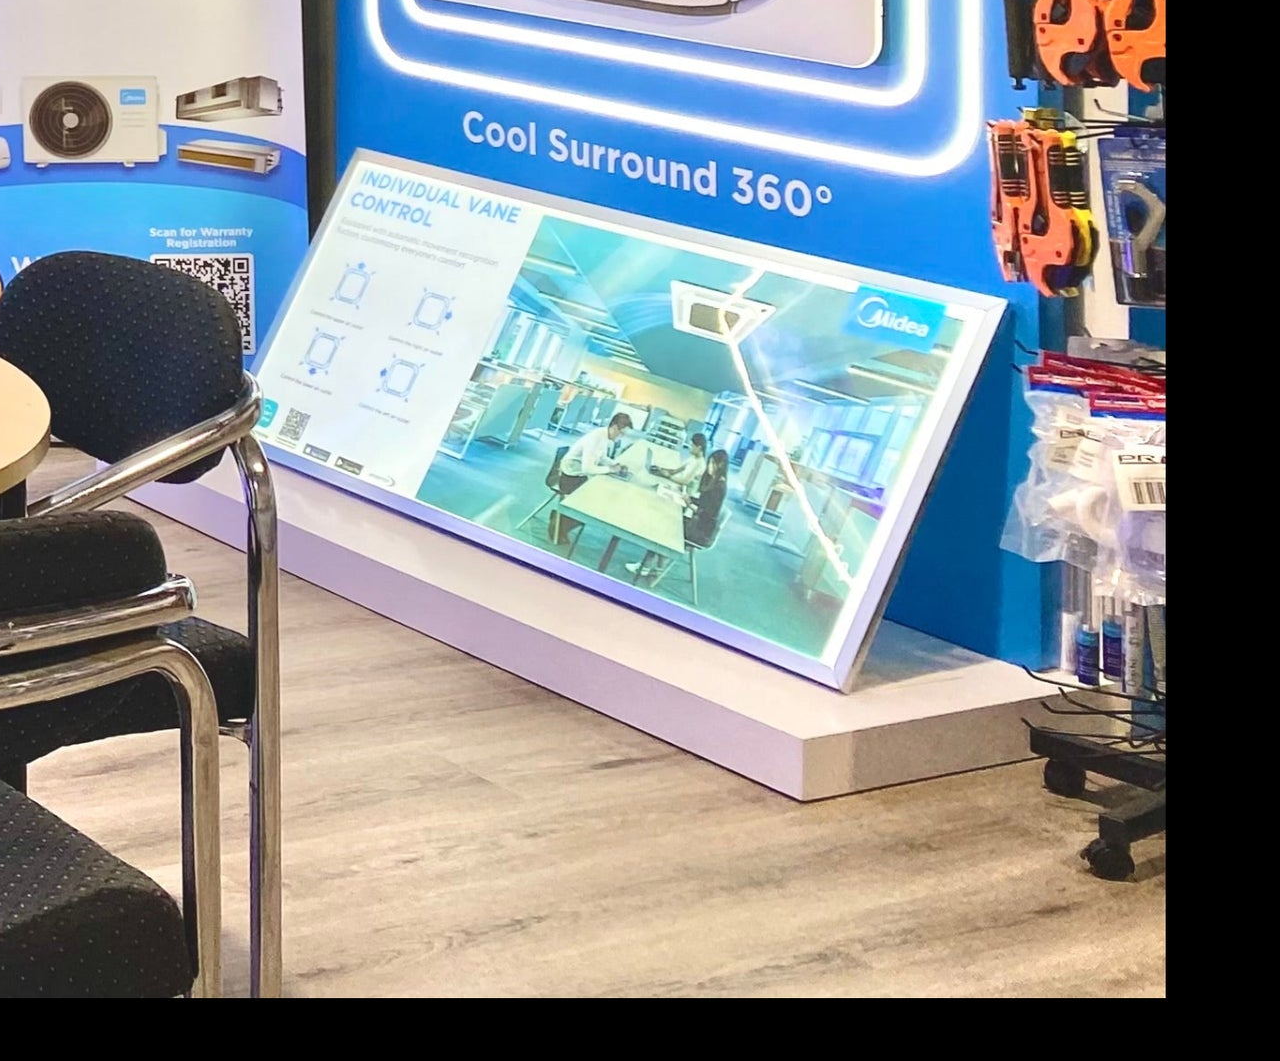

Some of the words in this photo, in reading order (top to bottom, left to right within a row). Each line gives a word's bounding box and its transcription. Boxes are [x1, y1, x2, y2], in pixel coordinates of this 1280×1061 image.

[461, 109, 538, 157] Cool
[548, 127, 720, 199] Surround
[730, 166, 834, 218] 360°
[350, 191, 433, 228] CONTROL
[359, 169, 461, 209] INDIVIDUAL
[466, 195, 523, 224] VANE
[149, 227, 177, 237] Scan
[180, 227, 197, 237] for
[200, 227, 254, 239] Warranty
[166, 238, 238, 250] Registration
[856, 295, 930, 339] Midea
